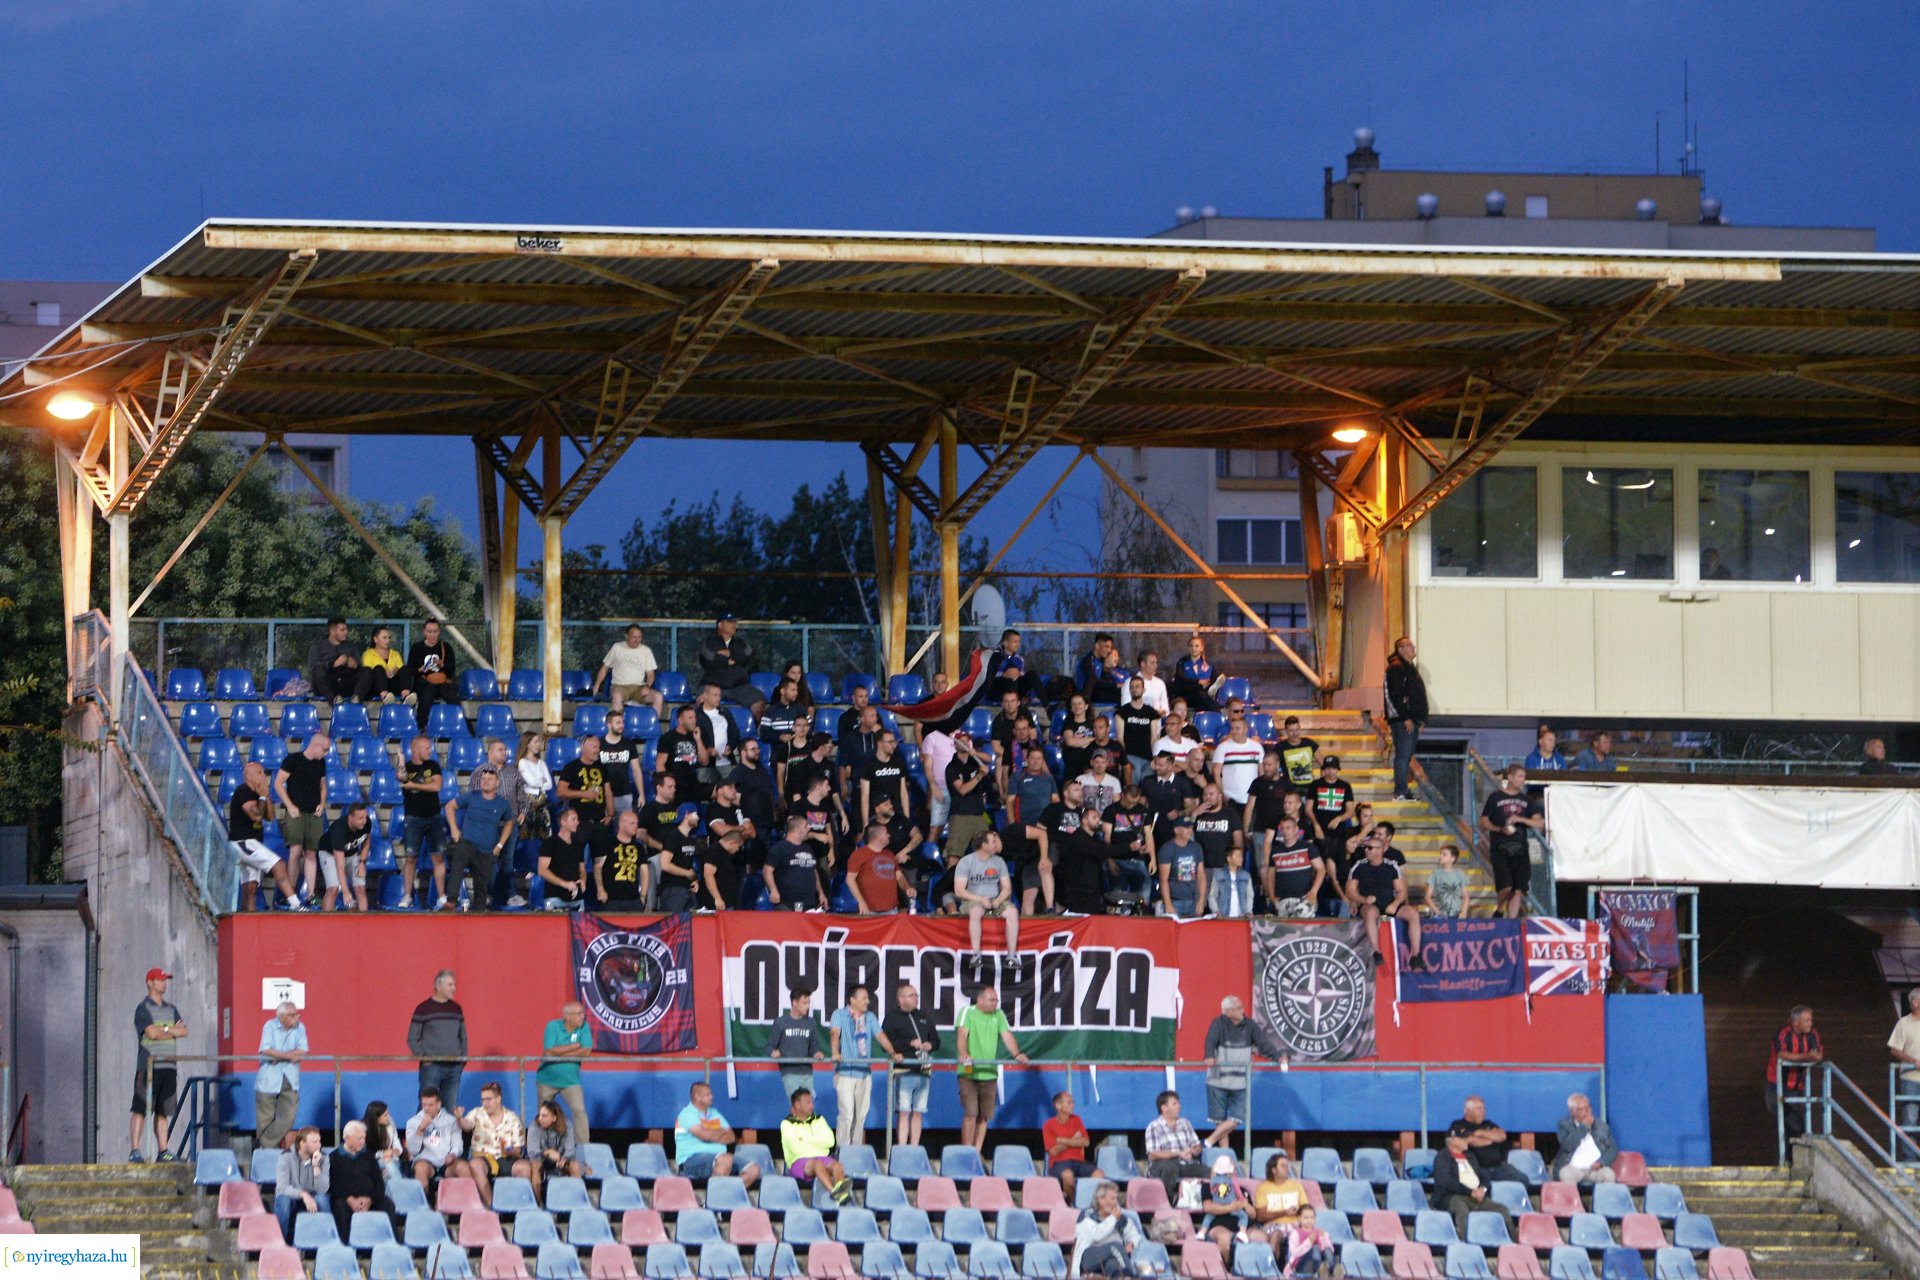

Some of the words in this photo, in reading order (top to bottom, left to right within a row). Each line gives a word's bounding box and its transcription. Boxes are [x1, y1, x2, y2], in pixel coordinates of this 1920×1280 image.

[578, 767, 602, 787] 19
[875, 766, 901, 777] adidas
[614, 843, 638, 862] 19
[614, 861, 637, 882] 28
[590, 934, 619, 957] OLD
[627, 933, 668, 959] FANS
[1299, 941, 1328, 955] 1928
[665, 968, 688, 986] 28
[1321, 960, 1348, 986] IFFS
[595, 1001, 663, 1030] SPARTACUS
[1283, 999, 1306, 1029] 1995
[1319, 997, 1350, 1033] SINCE
[1299, 1038, 1329, 1052] 1928
